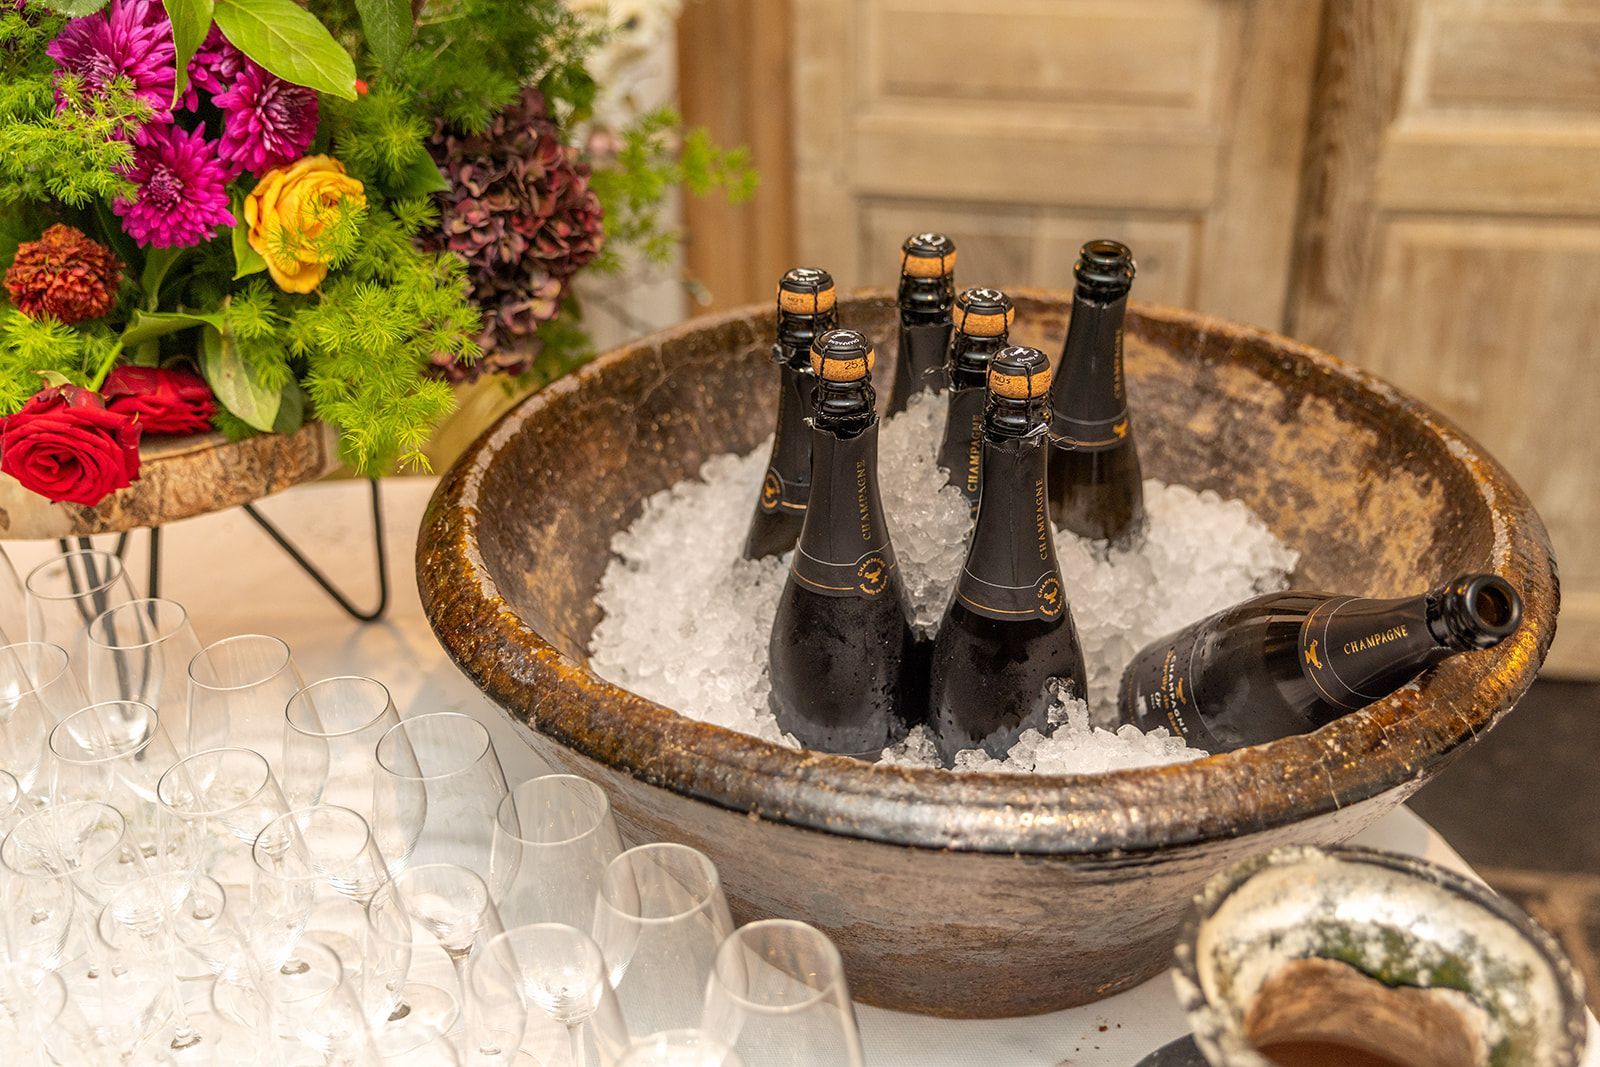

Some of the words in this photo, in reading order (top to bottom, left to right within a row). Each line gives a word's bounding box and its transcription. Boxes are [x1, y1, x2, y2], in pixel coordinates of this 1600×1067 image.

[967, 414, 983, 492] CHAMPAGNE
[856, 460, 872, 541] CHAMPAGNE
[1035, 478, 1048, 561] CHAMPAGNE
[1343, 624, 1409, 655] CHAMPAGNE
[1168, 655, 1189, 734] CHAMPAGNE
